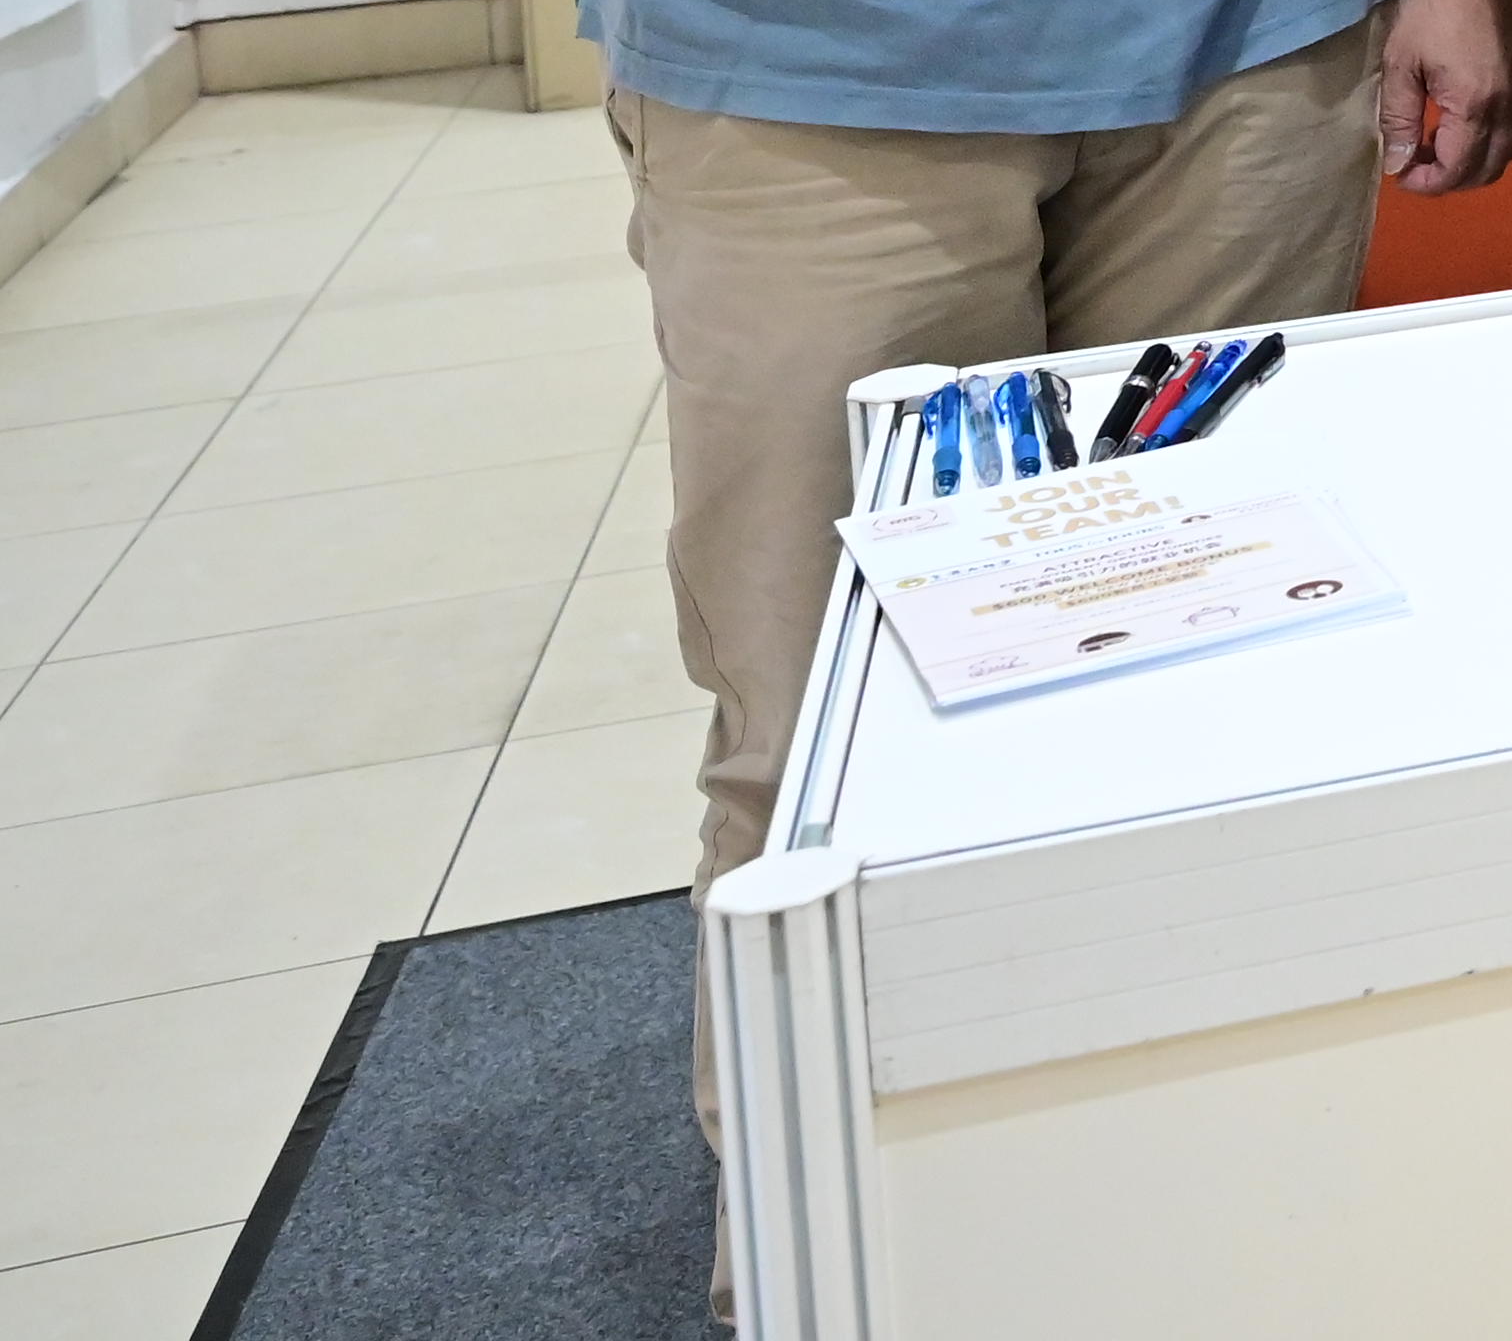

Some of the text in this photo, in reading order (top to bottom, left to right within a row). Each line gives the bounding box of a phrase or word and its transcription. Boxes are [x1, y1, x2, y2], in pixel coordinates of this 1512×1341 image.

[984, 469, 1134, 513] JOIN
[1007, 487, 1141, 525] OUR
[980, 494, 1186, 549] TEAM!
[1057, 564, 1174, 597] WELCOME
